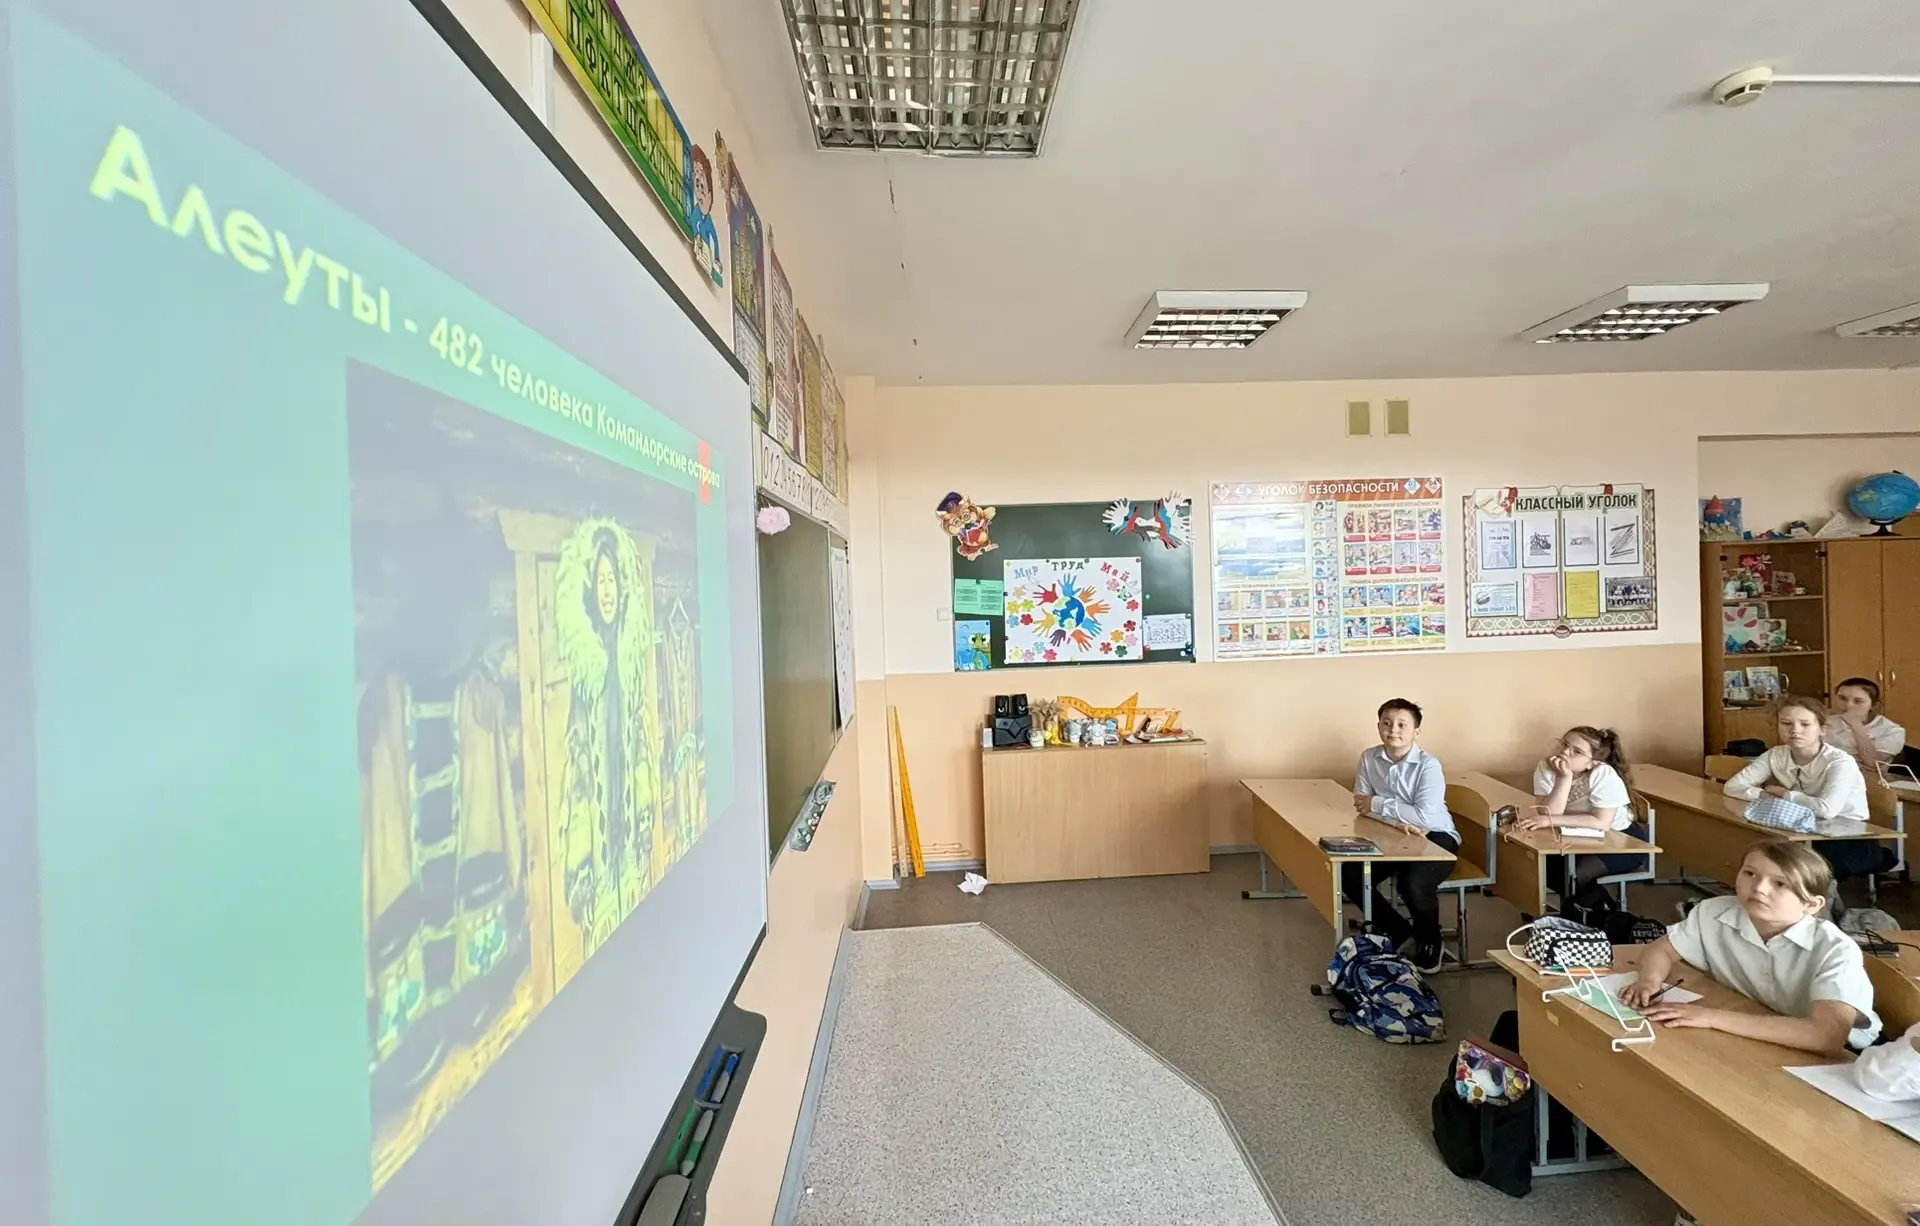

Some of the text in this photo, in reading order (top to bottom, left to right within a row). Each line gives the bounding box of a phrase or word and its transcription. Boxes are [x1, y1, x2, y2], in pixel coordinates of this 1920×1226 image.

[90, 124, 391, 334] Алеуты
[429, 316, 484, 376] 482
[490, 353, 594, 428] человека
[597, 402, 688, 473] Командорские
[688, 461, 721, 488] острова
[1257, 484, 1305, 497] УГОЛОК
[1309, 482, 1399, 495] БЕЗОПАСНОСТИ
[1516, 493, 1637, 510] КЛАССНЫЙ УГОЛОК
